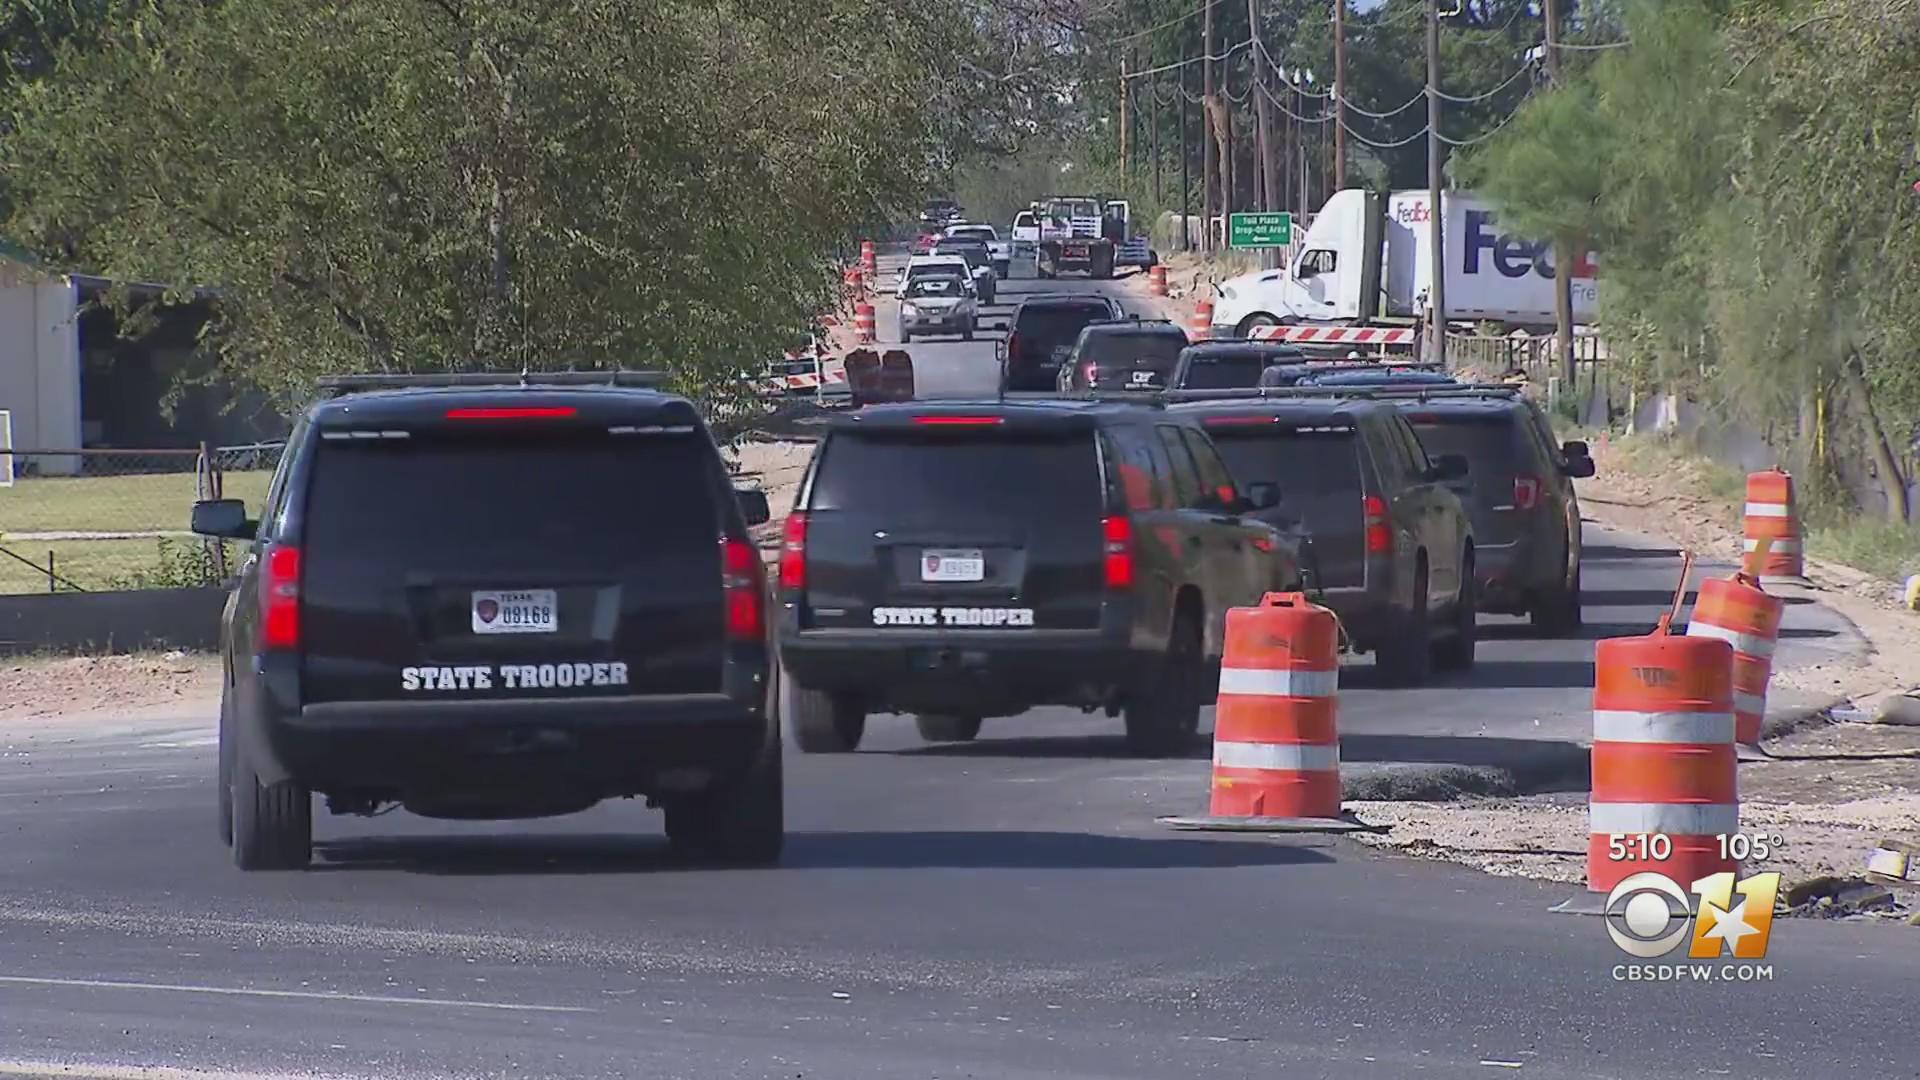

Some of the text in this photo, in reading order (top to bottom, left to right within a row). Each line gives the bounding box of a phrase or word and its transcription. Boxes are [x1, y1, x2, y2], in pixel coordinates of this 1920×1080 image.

[1242, 216, 1280, 225] Toll Plaza
[1397, 201, 1431, 222] FedEx
[1234, 225, 1287, 235] Drop-Off Area
[503, 606, 550, 624] 08168
[873, 607, 1034, 626] STATE TROOPER
[402, 662, 628, 691] STATE TROOPER
